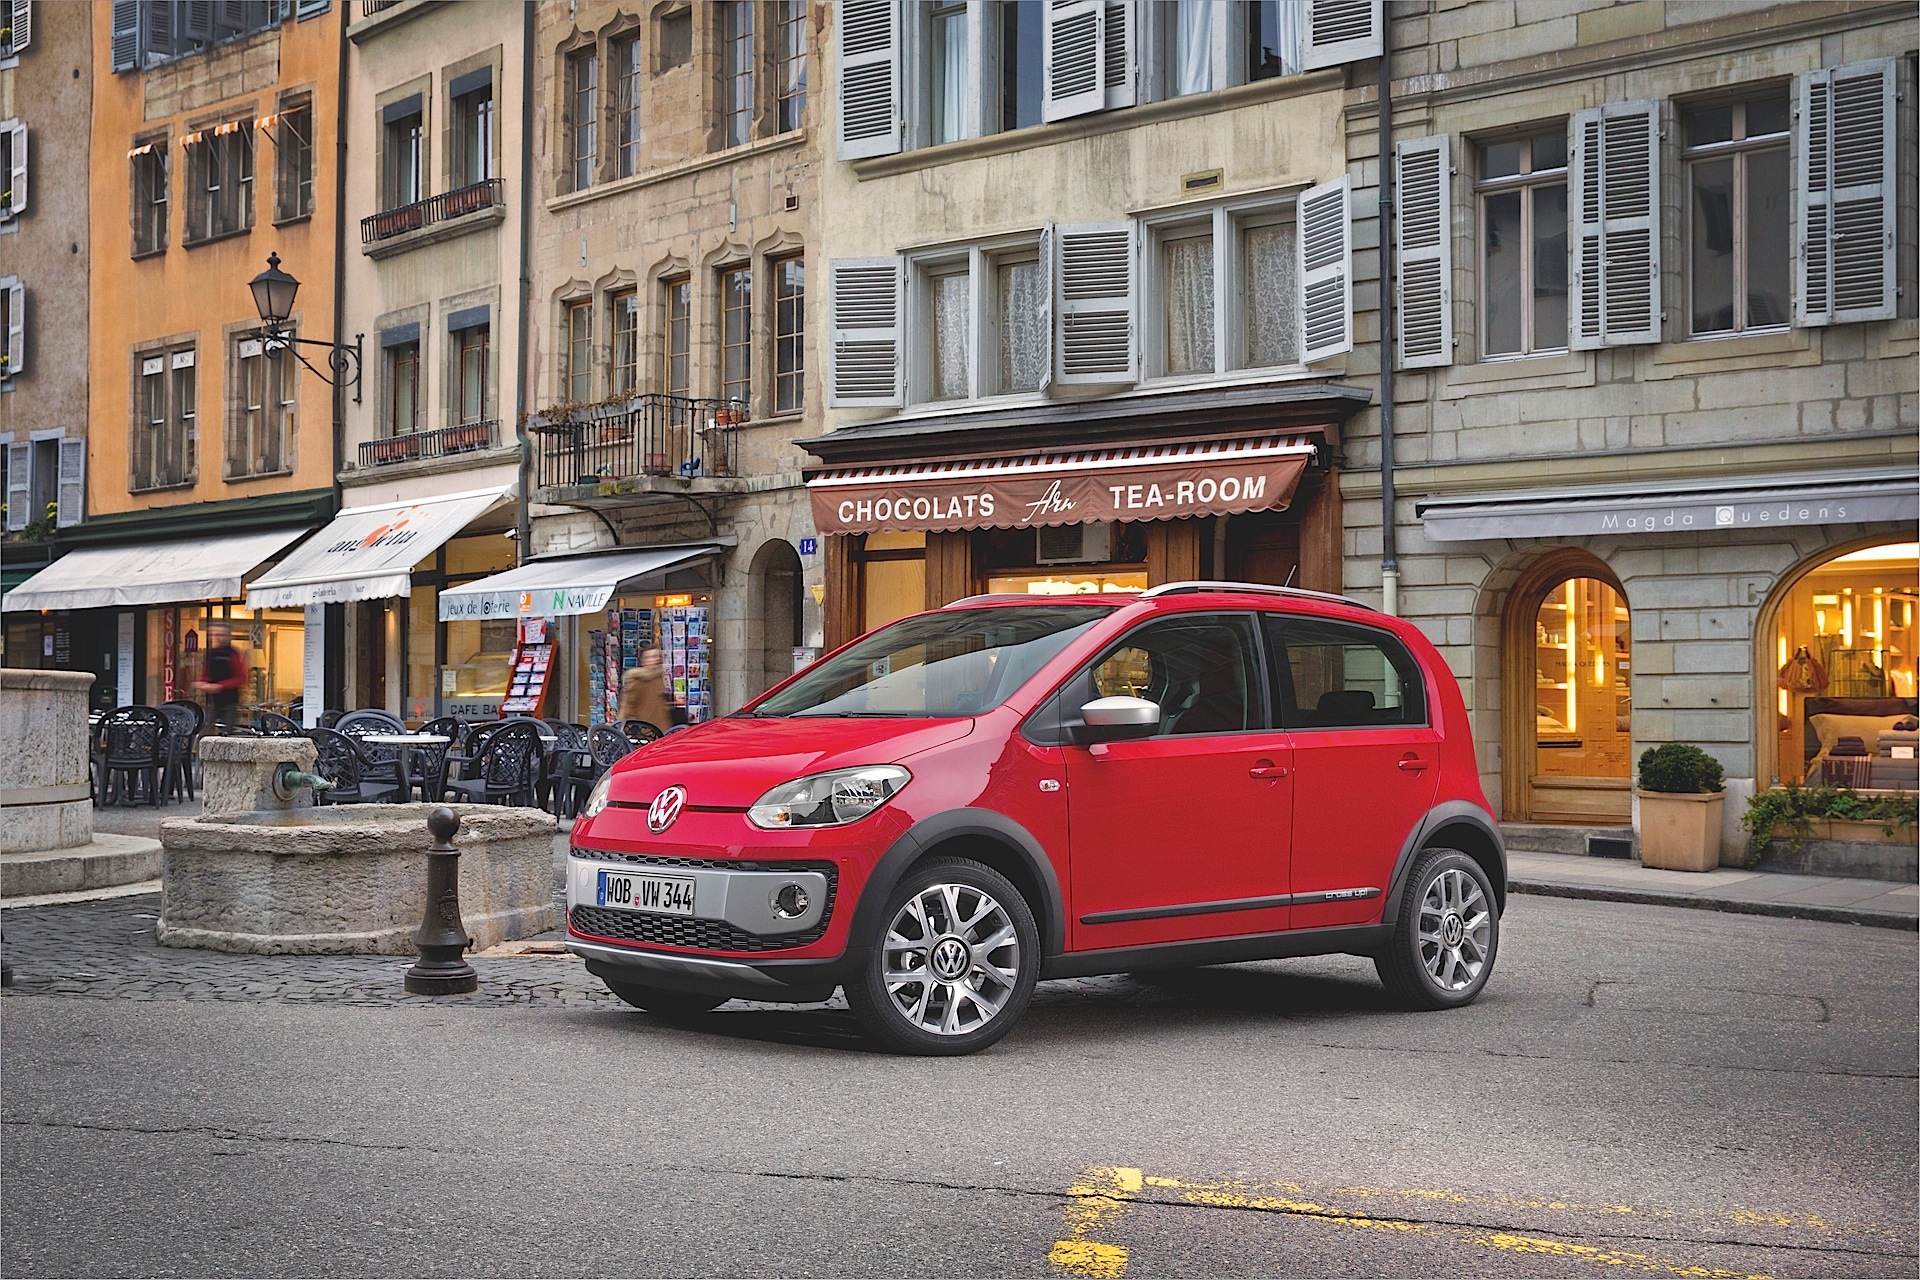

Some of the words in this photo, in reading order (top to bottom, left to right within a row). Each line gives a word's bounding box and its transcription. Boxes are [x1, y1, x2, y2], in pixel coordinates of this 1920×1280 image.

[837, 493, 994, 523] CHOCOLATS
[1109, 475, 1266, 510] TEA-ROOM
[1601, 510, 1693, 531] Magda
[1715, 504, 1846, 525] Quedens
[802, 540, 814, 553] 14
[446, 601, 464, 618] jeux
[467, 600, 477, 614] de
[480, 597, 510, 615] loterie
[567, 592, 606, 608] NAVILLE
[450, 704, 478, 715] CAFE
[607, 876, 632, 904] WOB
[642, 880, 661, 907] VW
[663, 882, 692, 911] 344
[1325, 890, 1352, 899] cross
